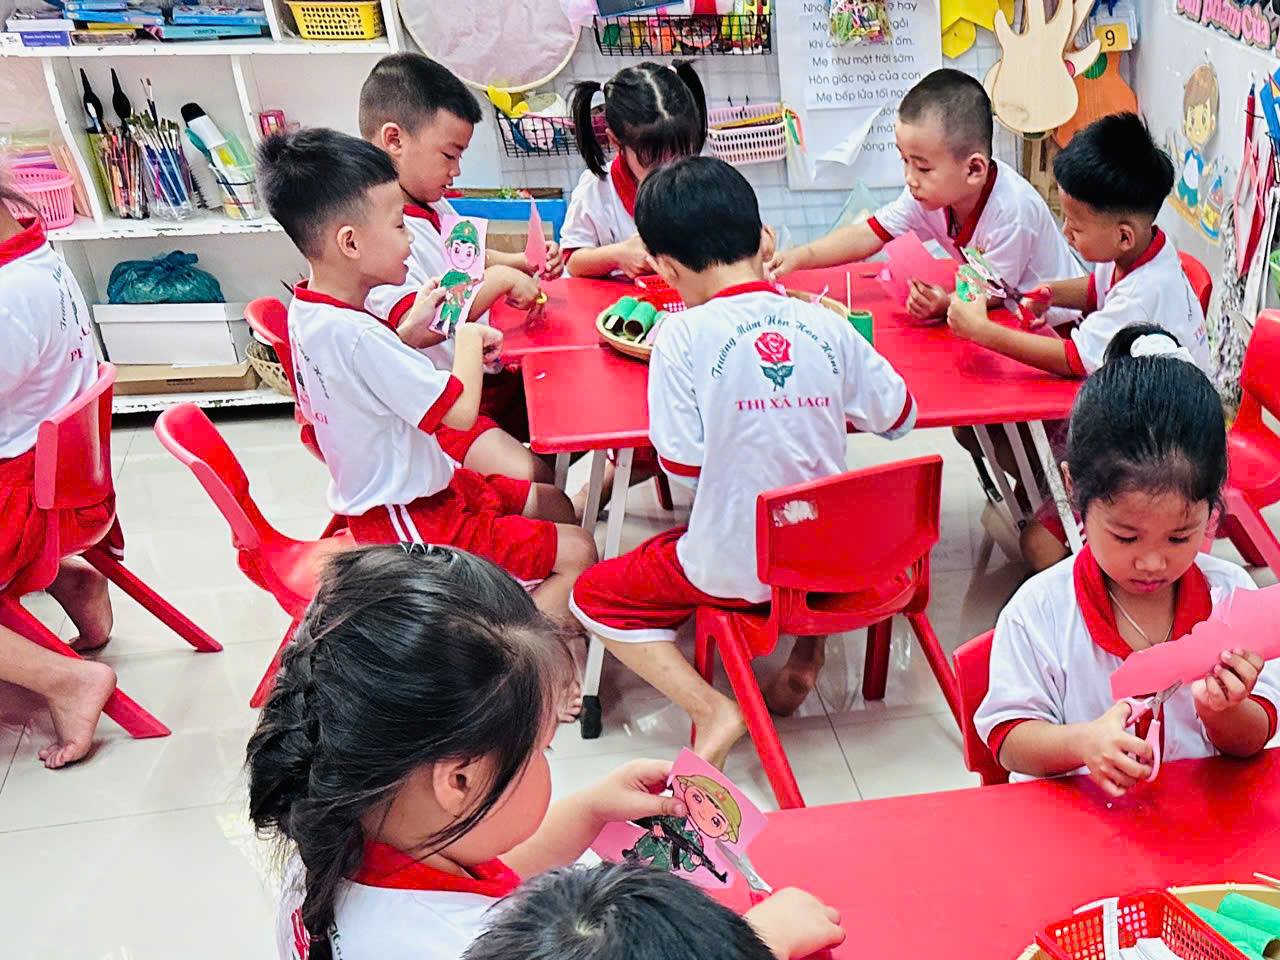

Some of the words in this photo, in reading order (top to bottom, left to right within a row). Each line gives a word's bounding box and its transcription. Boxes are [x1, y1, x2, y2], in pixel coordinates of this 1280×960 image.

[897, 1, 918, 12] hay
[1105, 29, 1116, 47] 9
[812, 56, 829, 67] Mẹ
[901, 71, 921, 80] con
[711, 337, 736, 379] Trường
[735, 398, 766, 413] THỊ
[769, 395, 792, 410] XÃ
